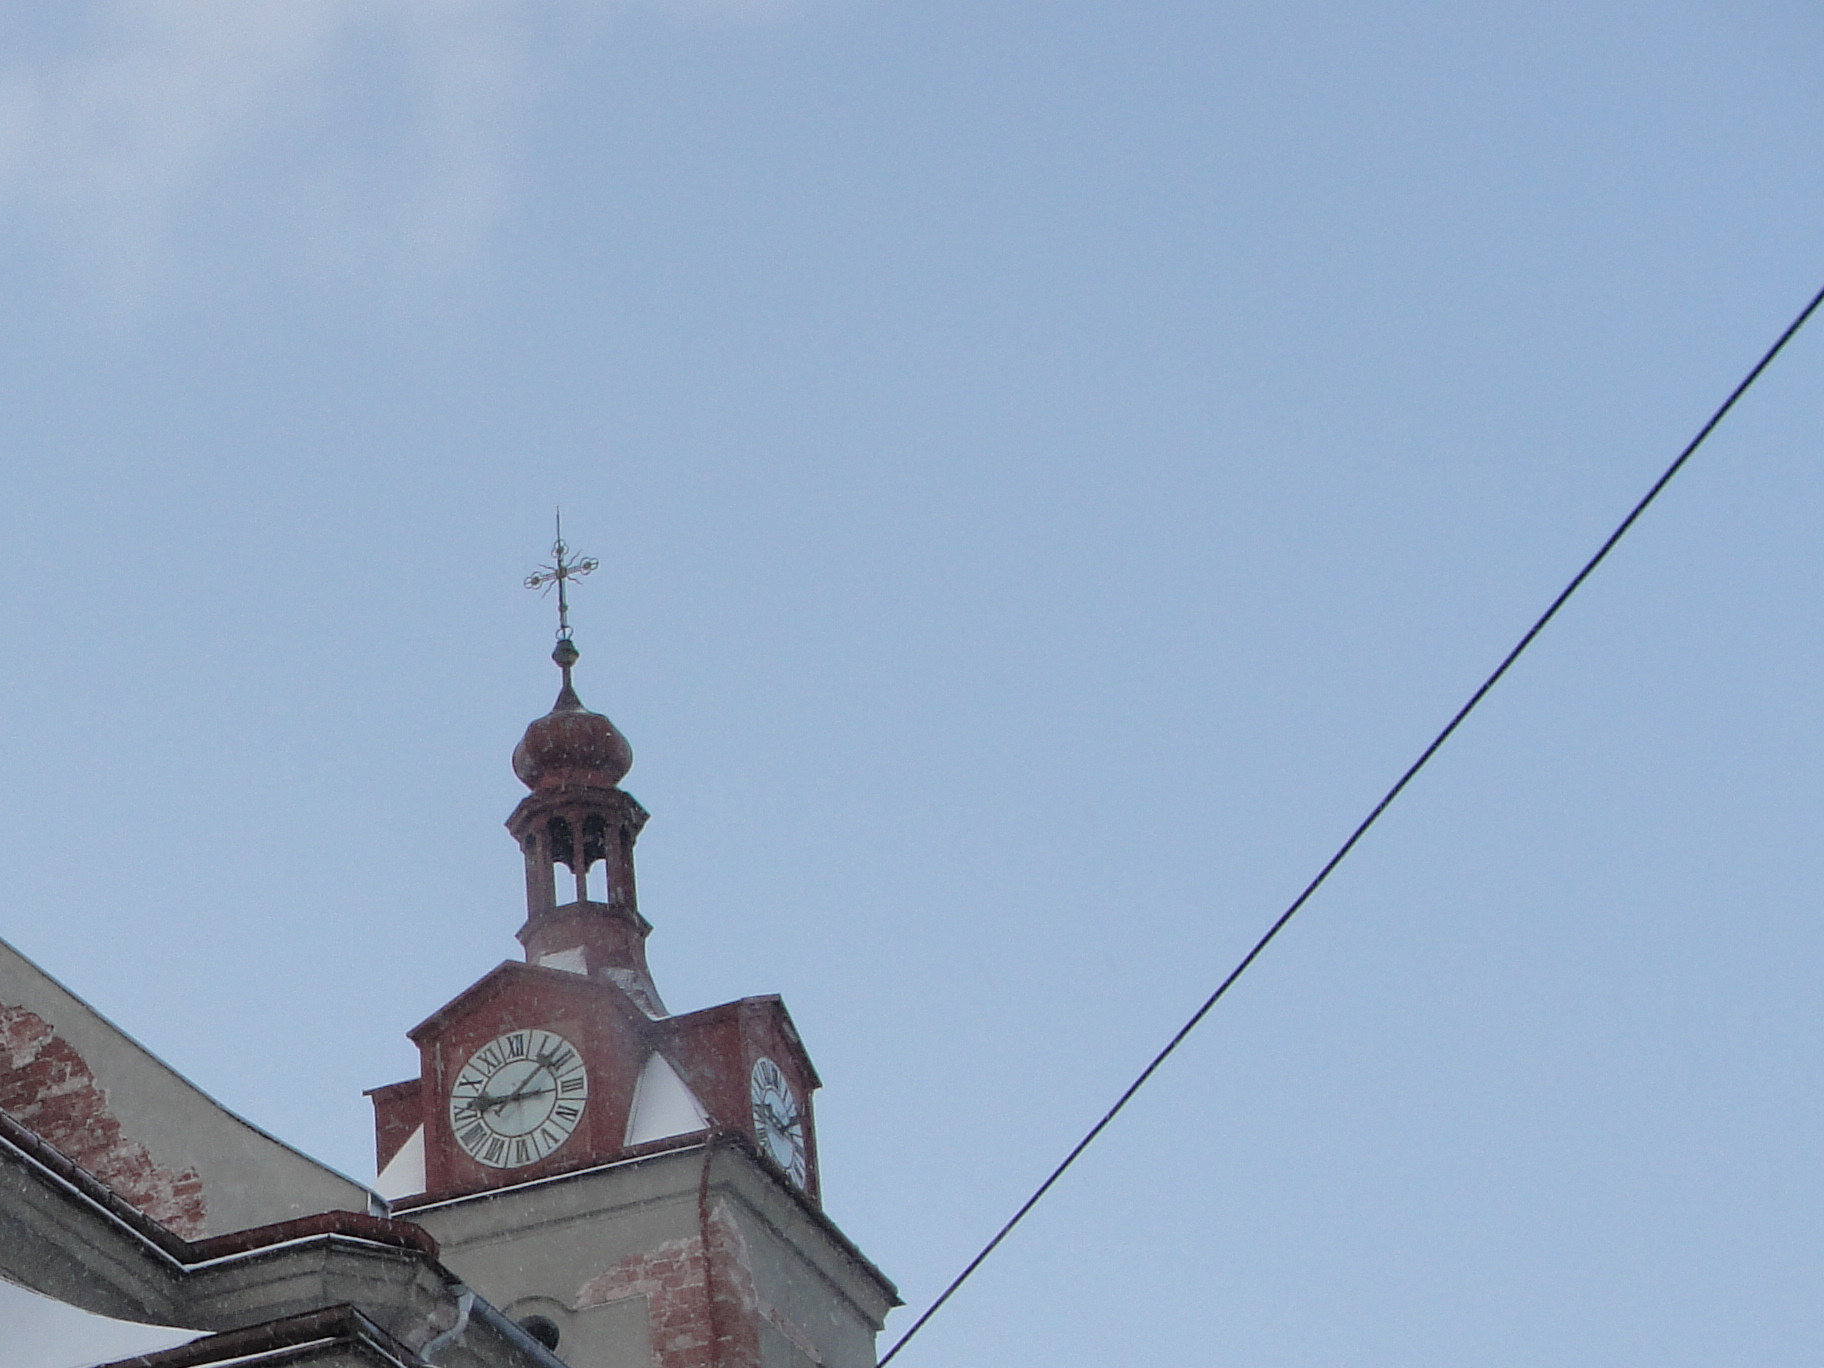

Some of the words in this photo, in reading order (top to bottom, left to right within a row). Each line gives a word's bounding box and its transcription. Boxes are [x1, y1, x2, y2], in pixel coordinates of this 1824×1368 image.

[506, 1033, 524, 1059] XII
[476, 1047, 502, 1074] XI
[458, 1074, 483, 1093] X
[561, 1075, 584, 1093] III
[555, 1104, 580, 1123] IV
[460, 1122, 487, 1153] VIII
[541, 1127, 562, 1150] V
[483, 1137, 506, 1164] VII
[516, 1138, 531, 1163] VI
